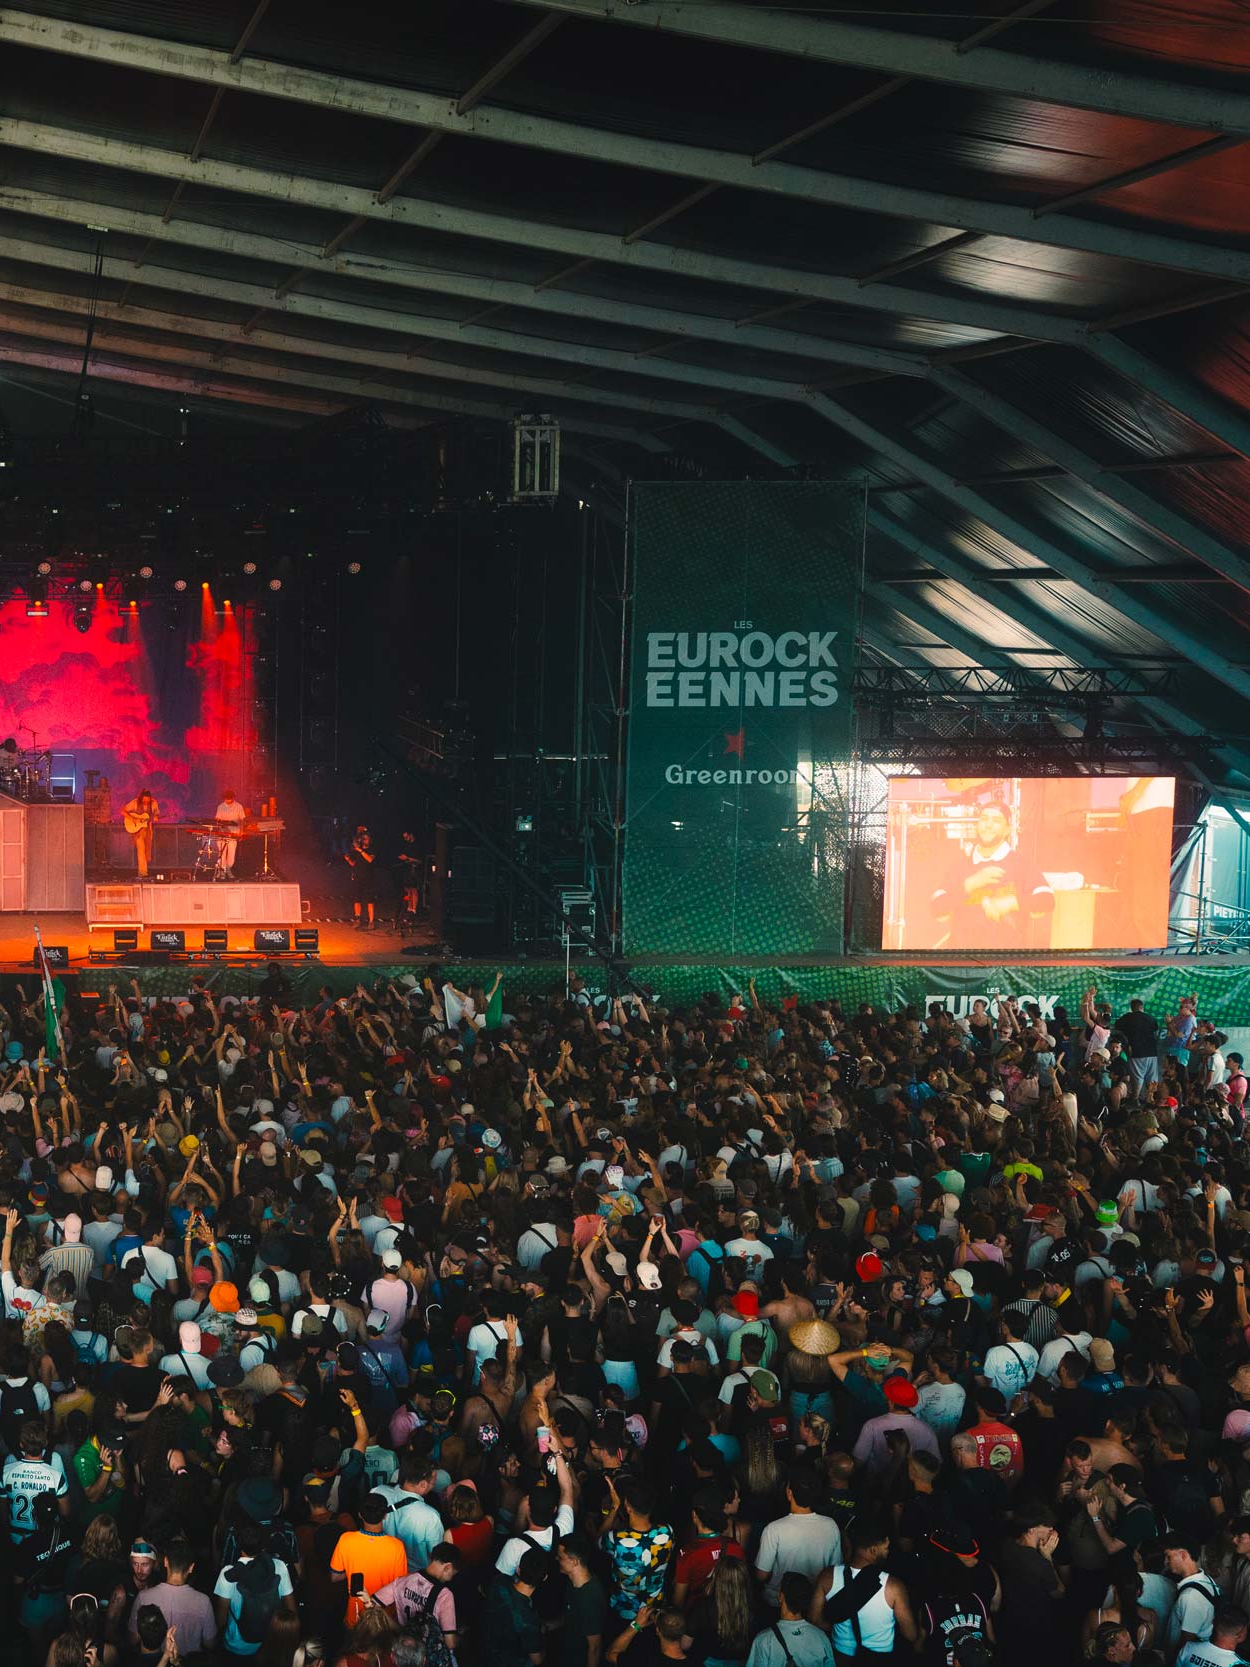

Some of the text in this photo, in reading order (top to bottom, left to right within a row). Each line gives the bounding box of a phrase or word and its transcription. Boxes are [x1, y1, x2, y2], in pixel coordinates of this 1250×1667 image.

[733, 620, 753, 630] LES
[646, 631, 839, 668] EUROCK
[645, 671, 839, 707] EENNES
[21, 1481, 47, 1491] RONALDO
